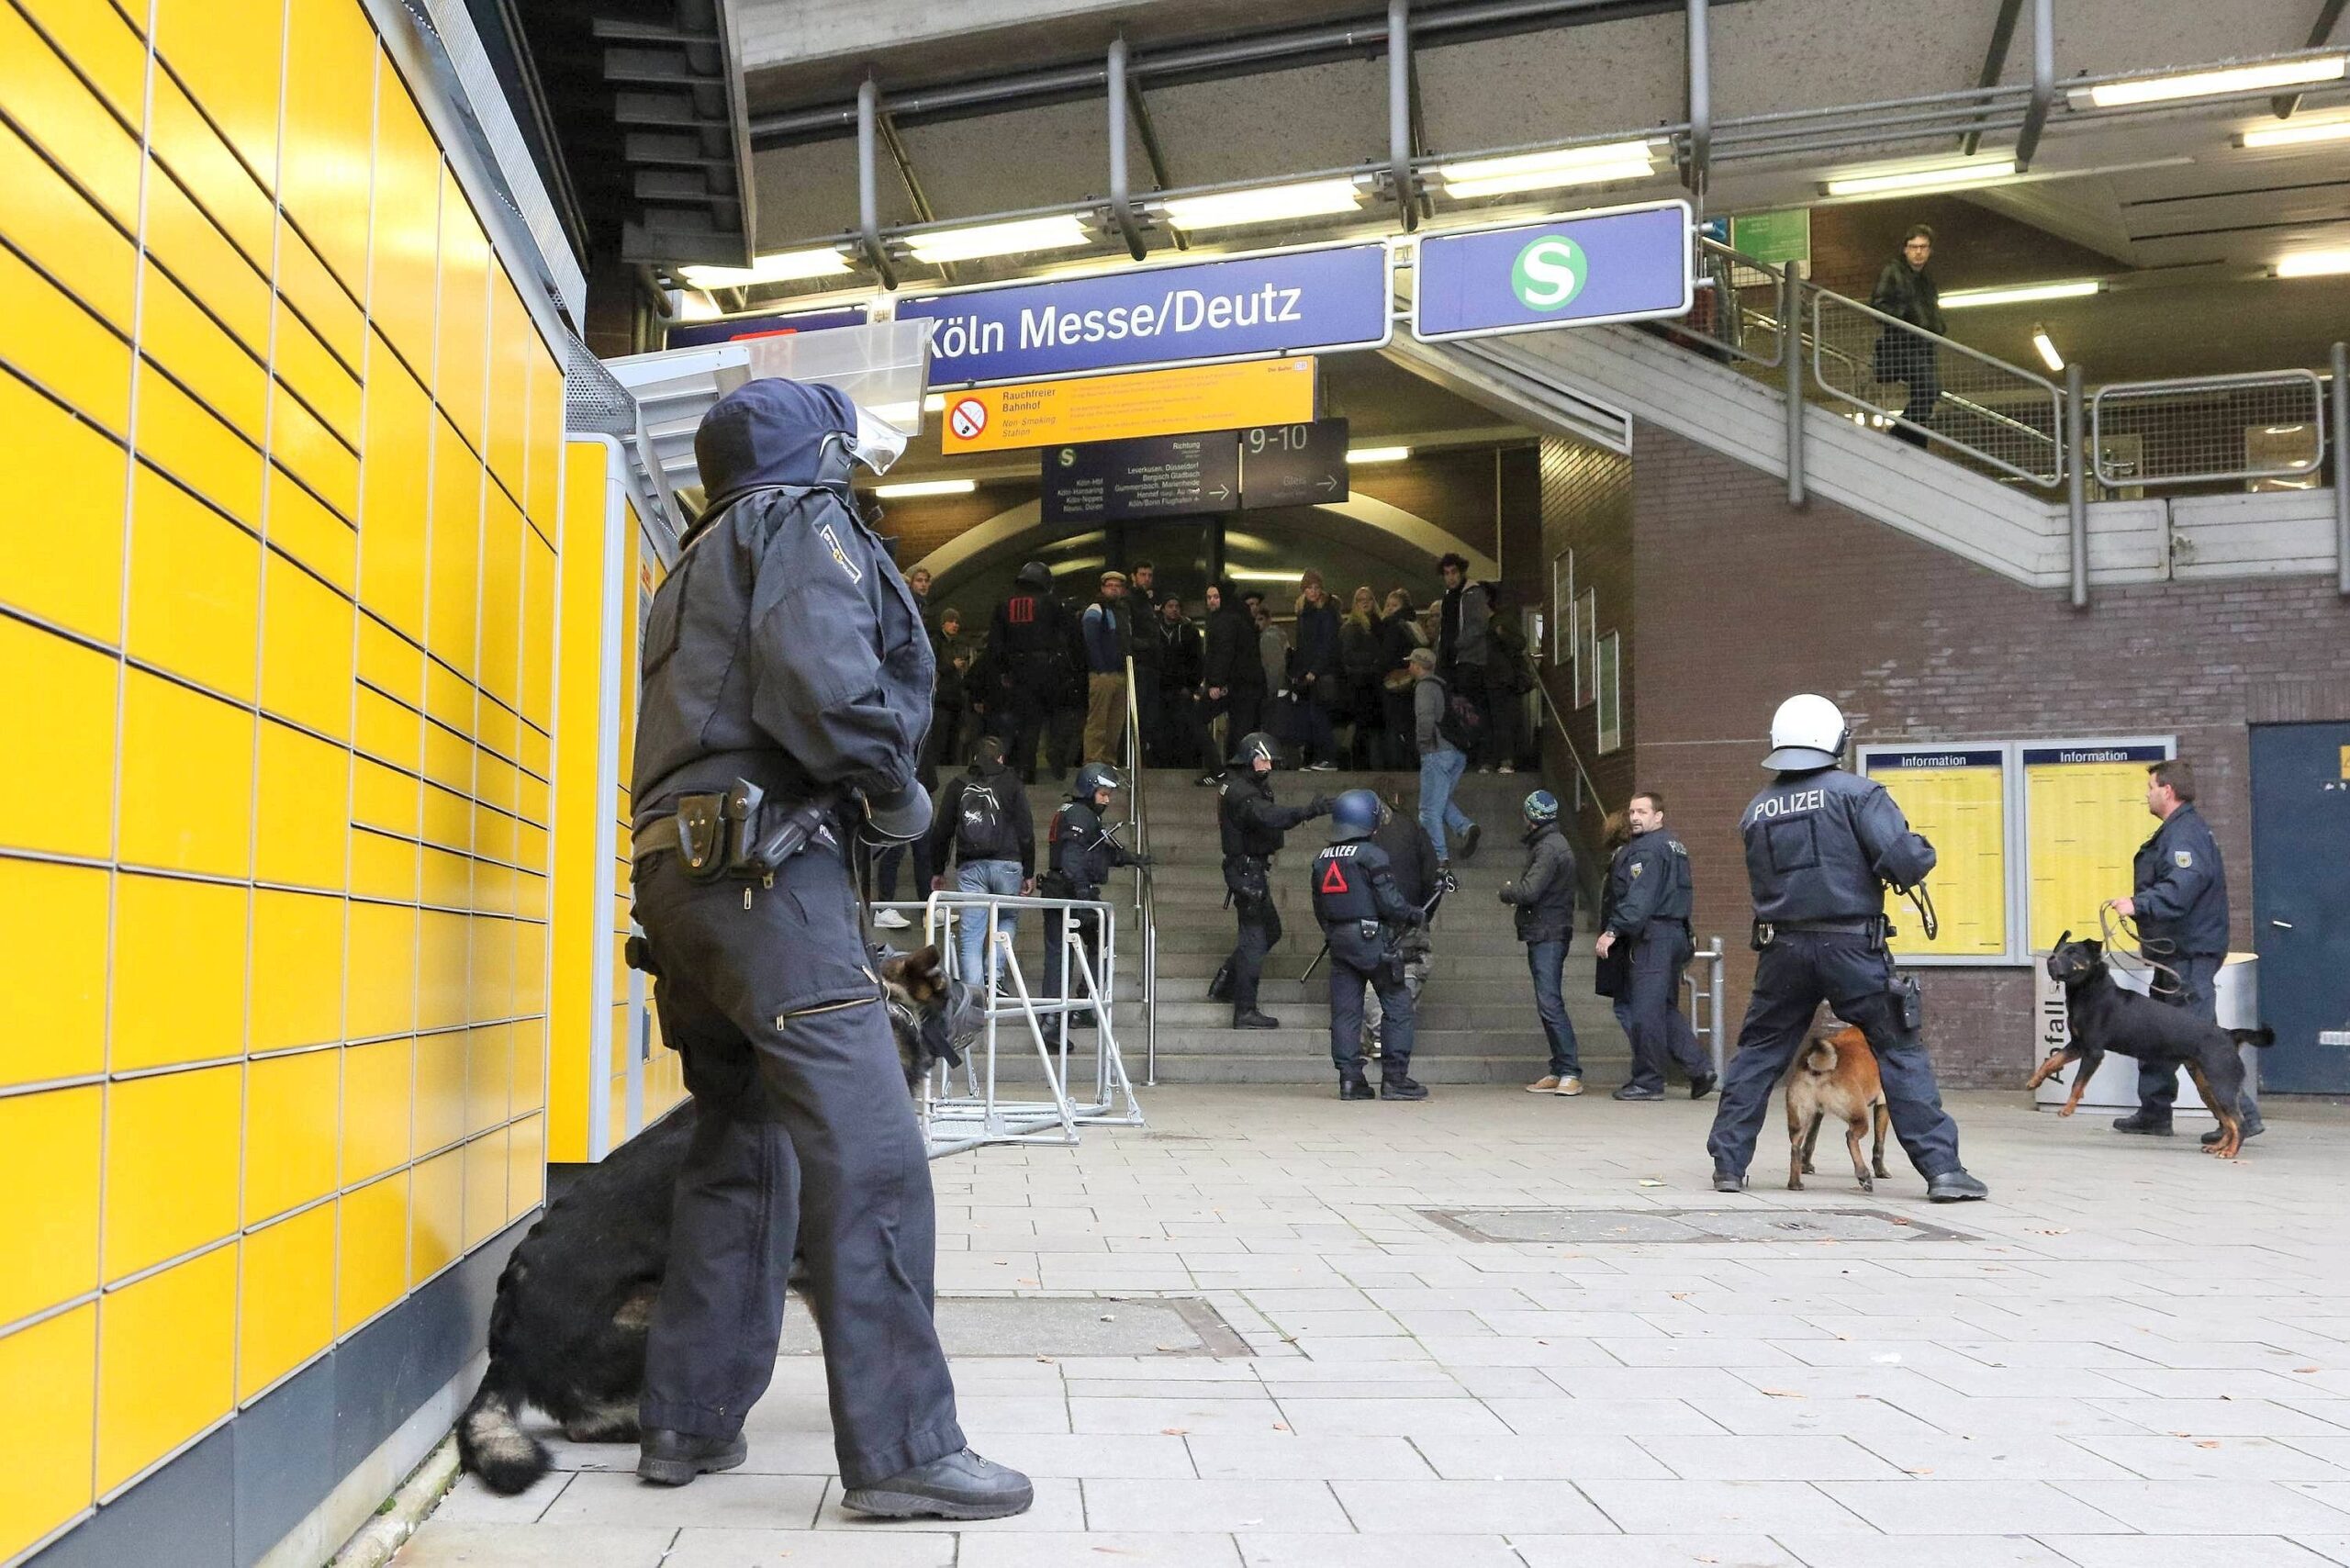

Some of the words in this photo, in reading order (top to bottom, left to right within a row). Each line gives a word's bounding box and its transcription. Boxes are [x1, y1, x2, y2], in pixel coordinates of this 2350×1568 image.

[1524, 241, 1575, 306] S
[927, 315, 1004, 359] Köln
[1020, 283, 1302, 350] Messe/Deutz
[1002, 387, 1056, 400] Rauchfreier
[1002, 401, 1041, 412] Bahnhof
[1002, 429, 1031, 438] Station
[1249, 424, 1308, 454] 9-10
[1173, 442, 1201, 450] Richtung
[1060, 448, 1074, 466] S
[1902, 755, 1966, 767] Information
[2060, 751, 2128, 763] Information
[1753, 789, 1825, 822] POLIZEI
[1319, 846, 1359, 859] POLIZEI
